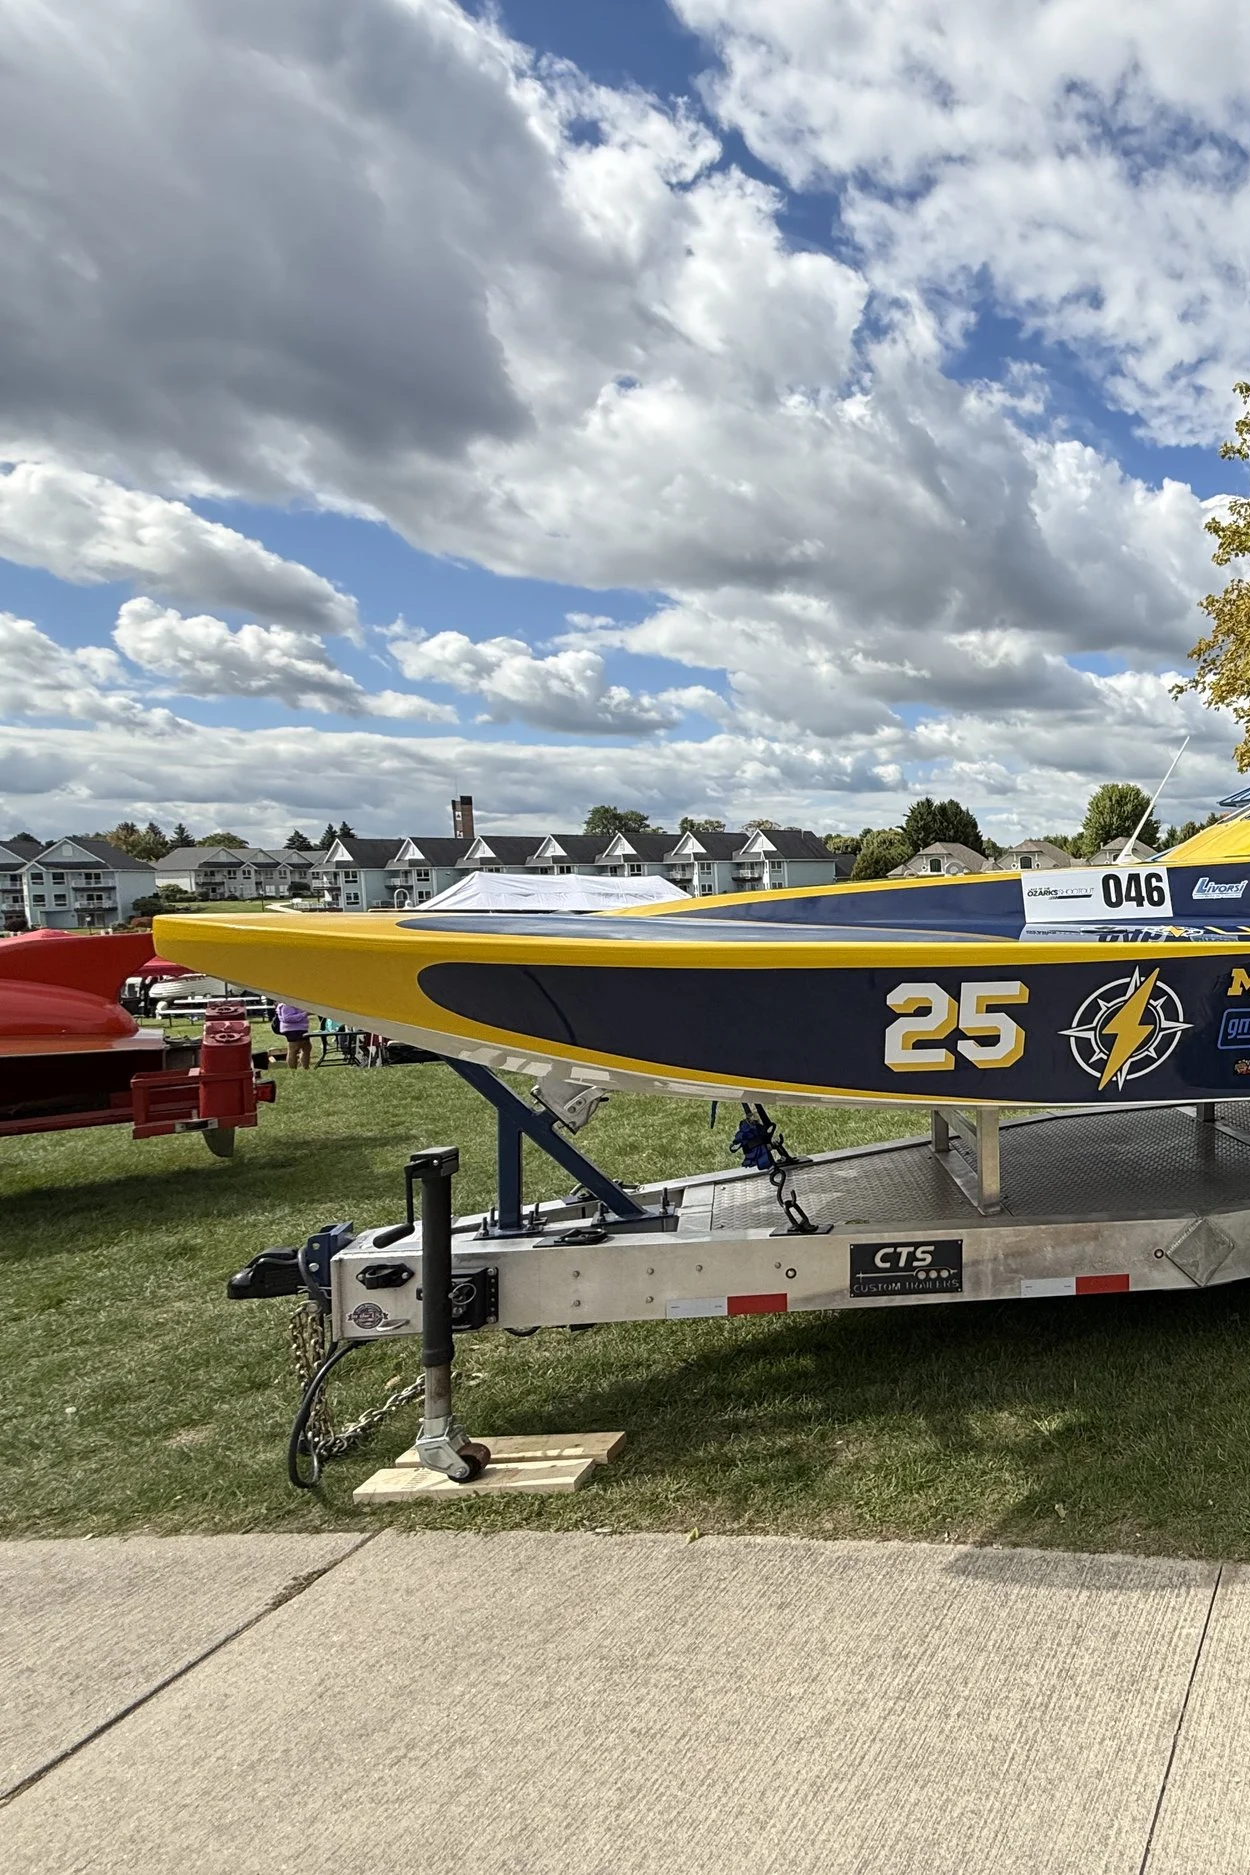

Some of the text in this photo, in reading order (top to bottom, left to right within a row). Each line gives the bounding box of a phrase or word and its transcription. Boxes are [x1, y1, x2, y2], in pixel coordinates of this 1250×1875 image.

[1027, 889, 1059, 897] OZARKS
[1101, 872, 1166, 908] 046
[884, 980, 1029, 1072] 25
[874, 1245, 935, 1268] CTS
[853, 1279, 960, 1293] CUSTOM TRAILERS
